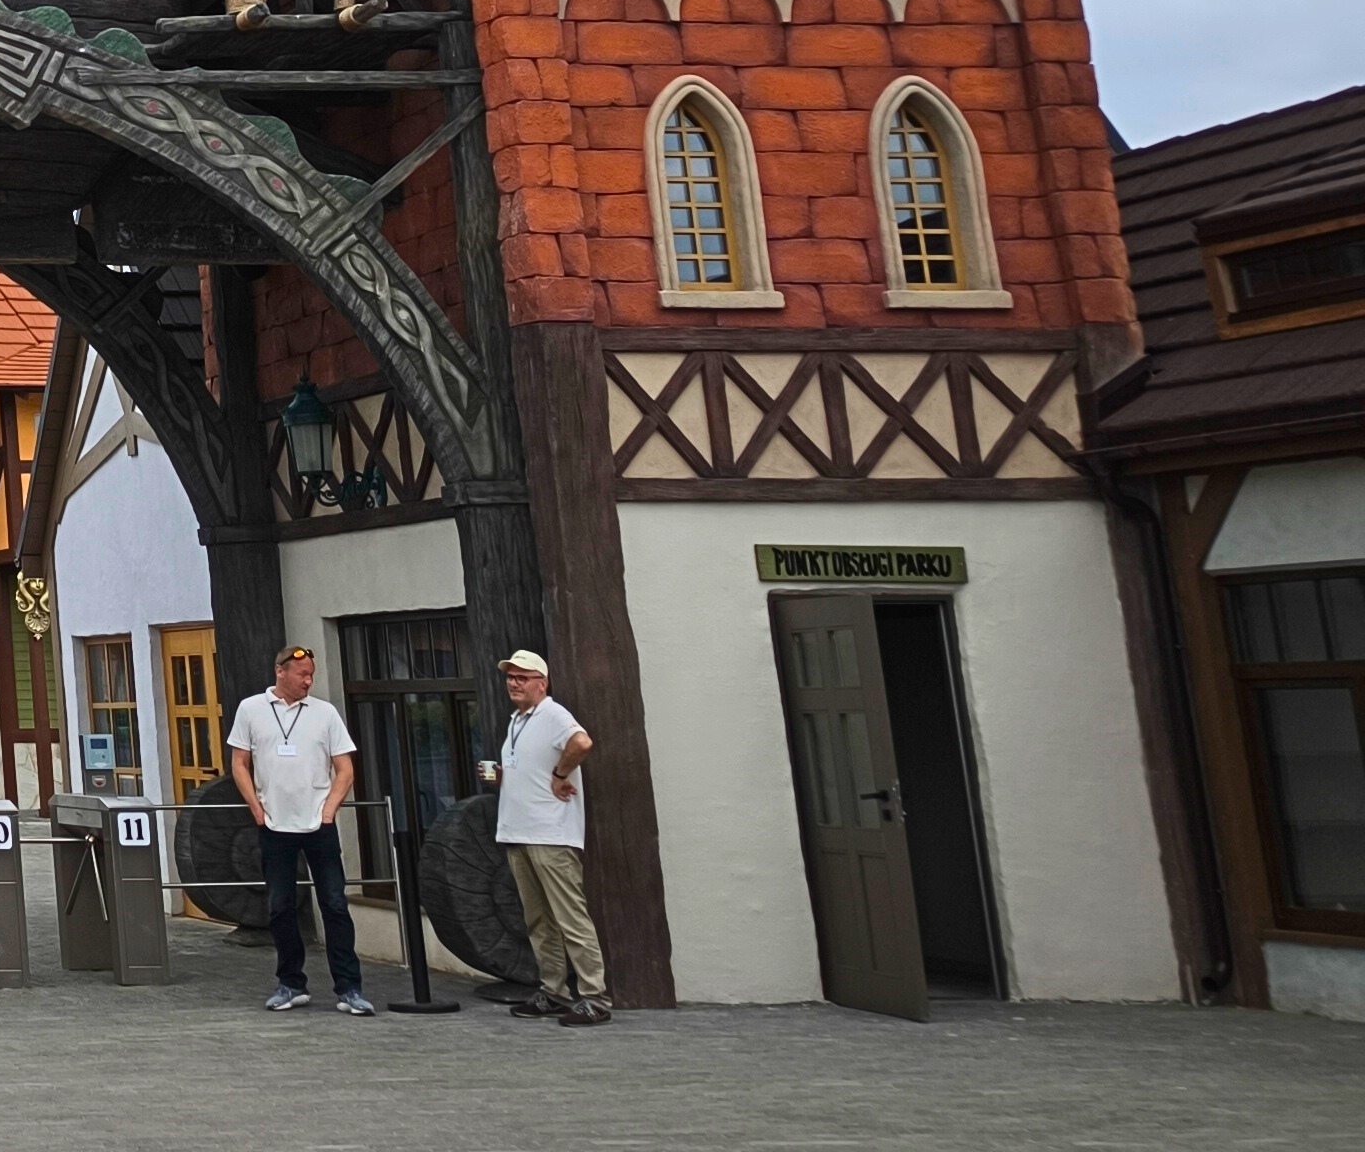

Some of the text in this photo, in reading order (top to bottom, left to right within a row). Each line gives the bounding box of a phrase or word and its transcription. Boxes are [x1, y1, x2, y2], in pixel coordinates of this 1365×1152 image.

[772, 547, 829, 577] PUNKT
[896, 552, 952, 577] PARKU
[123, 818, 145, 840] 11
